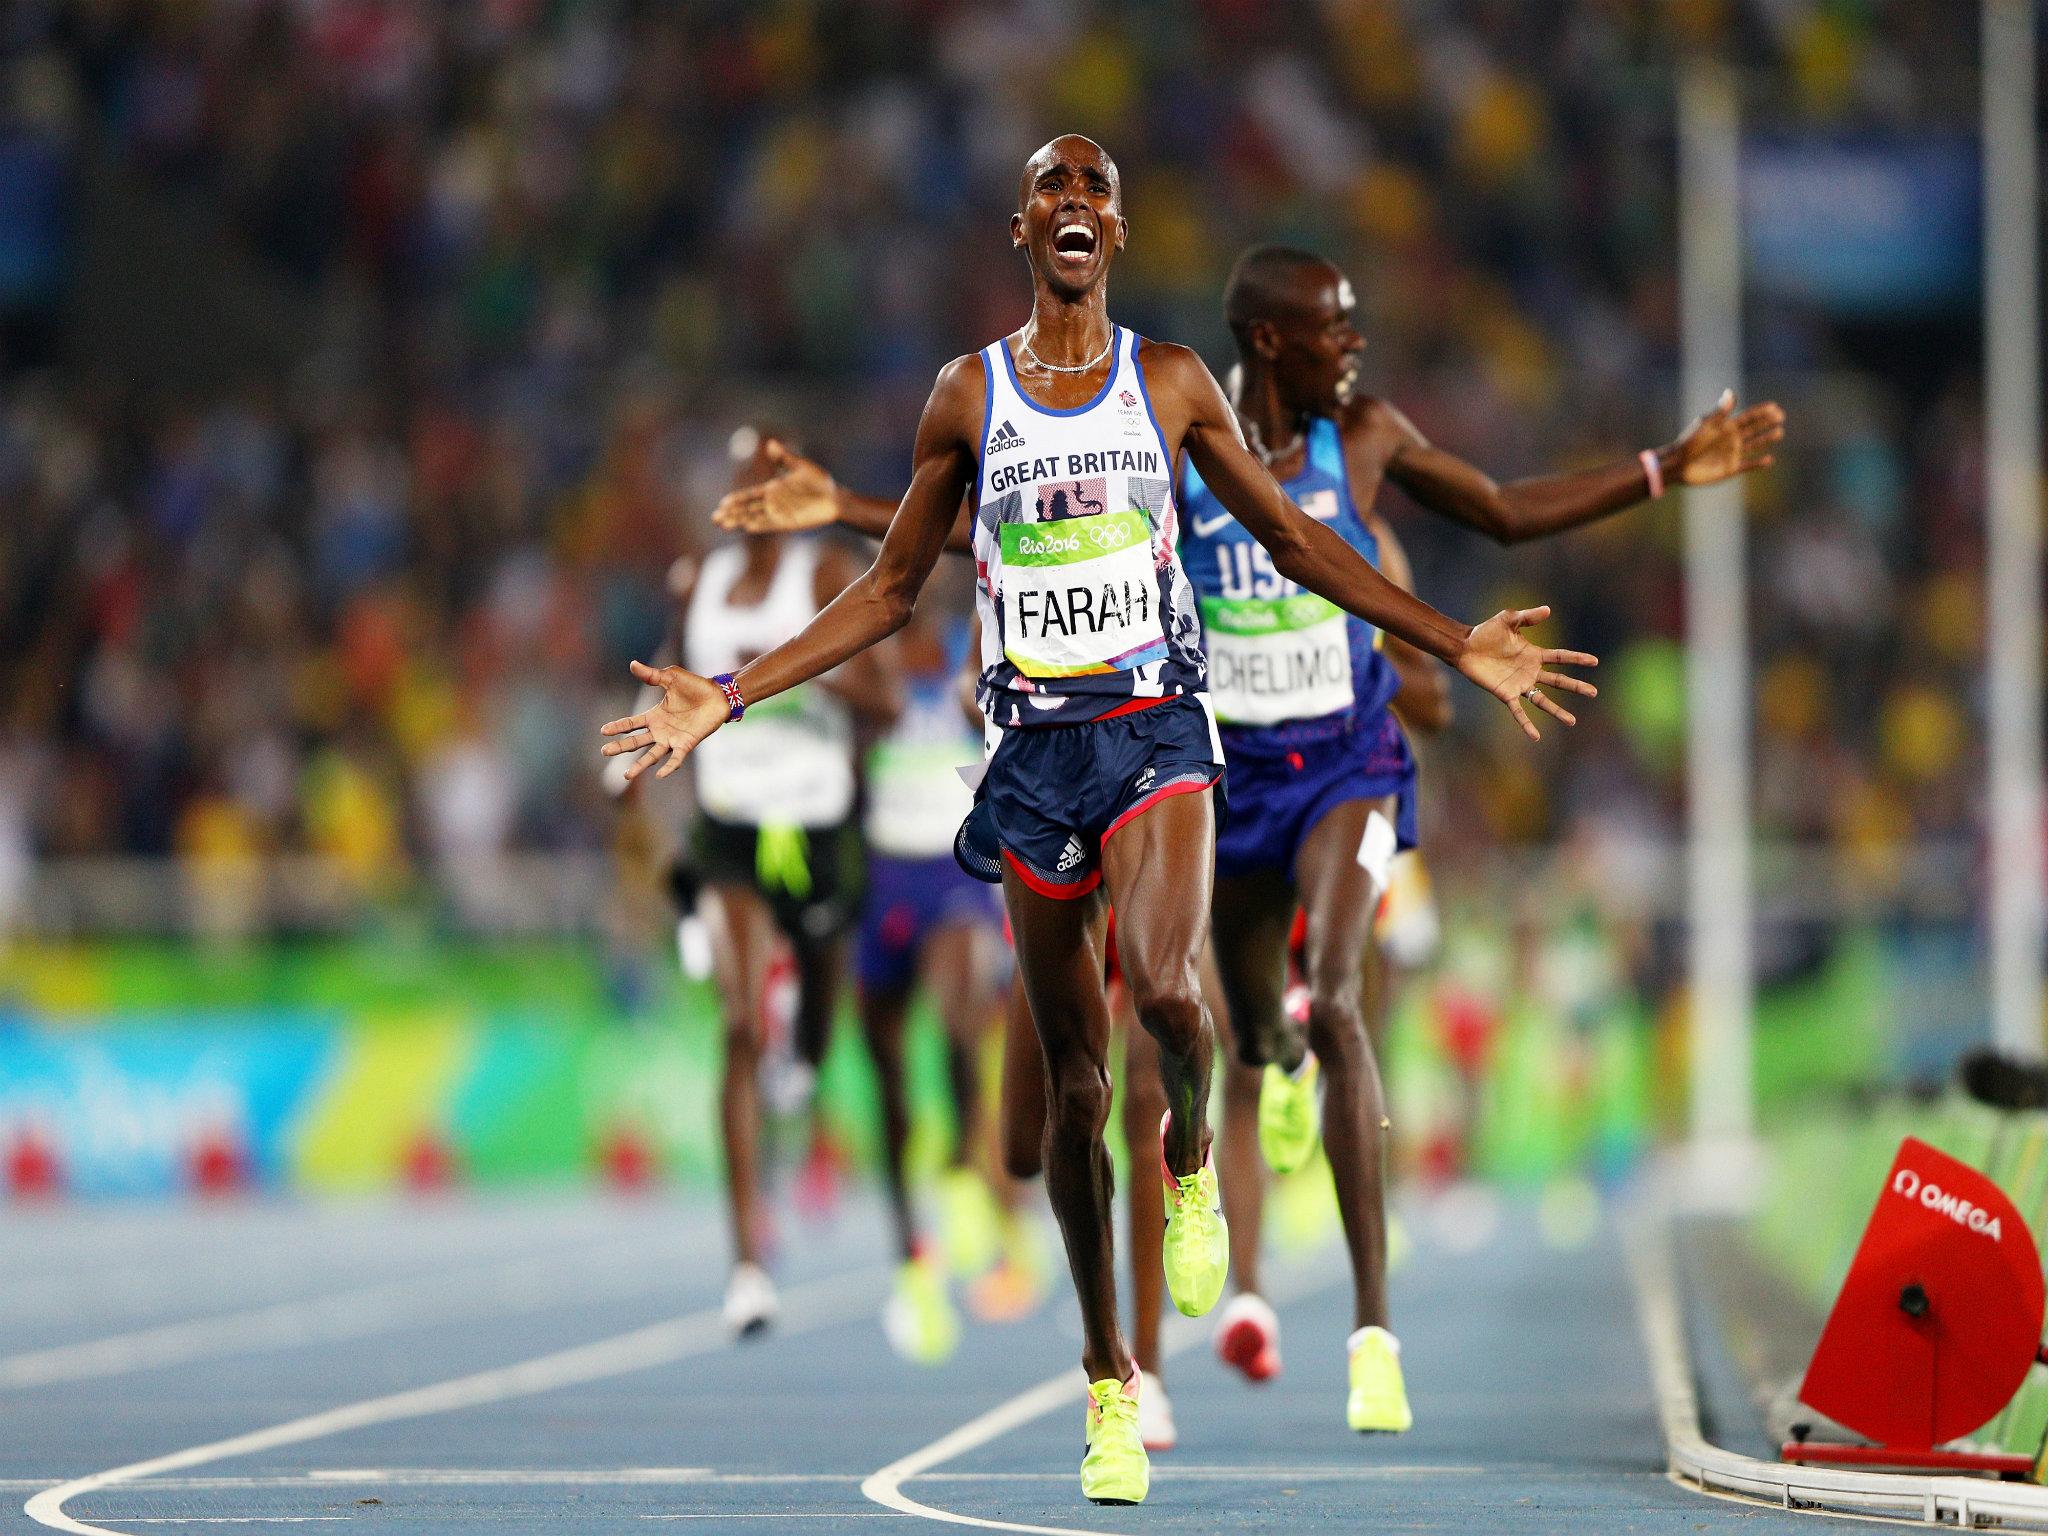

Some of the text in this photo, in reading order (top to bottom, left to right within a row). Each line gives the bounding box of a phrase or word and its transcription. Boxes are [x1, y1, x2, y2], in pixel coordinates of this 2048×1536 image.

[986, 437, 1026, 456] adidas
[990, 450, 1158, 493] GREAT BRITAIN
[1018, 579, 1149, 640] FARAH
[1920, 1183, 2003, 1243] OMEGA
